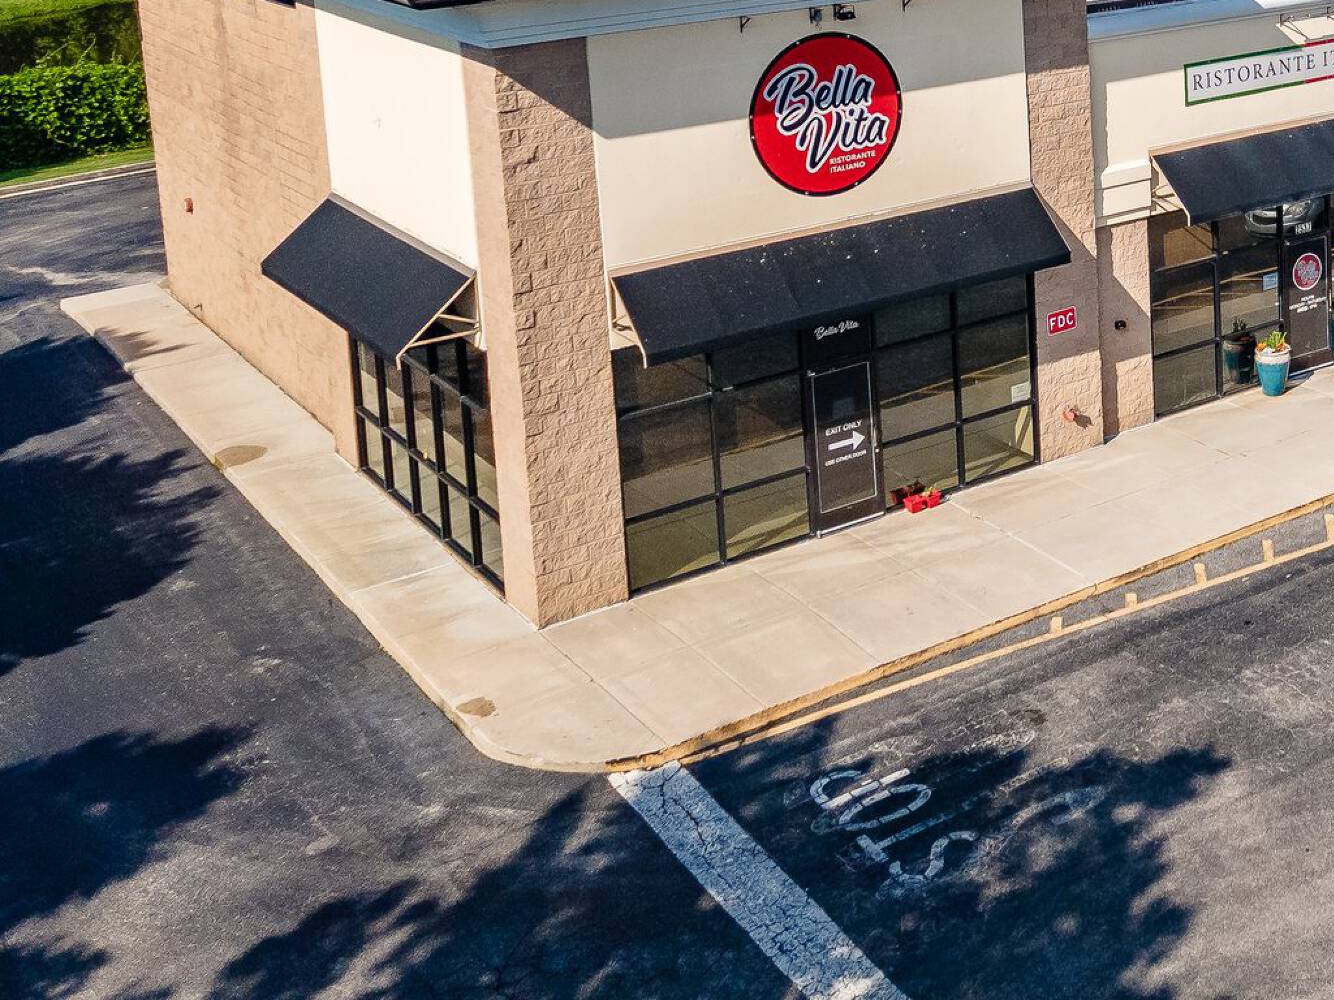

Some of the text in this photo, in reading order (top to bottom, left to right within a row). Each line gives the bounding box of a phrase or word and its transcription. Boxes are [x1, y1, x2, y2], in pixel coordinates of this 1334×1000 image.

[1193, 55, 1316, 91] RISTORANTE
[763, 63, 875, 136] Bella
[796, 107, 890, 174] Vita
[829, 150, 876, 164] RISTORANTE
[830, 161, 866, 173] ITALIANO
[1049, 312, 1074, 331] FDC
[825, 419, 863, 436] EXIT ONLY
[809, 767, 980, 884] STOP
